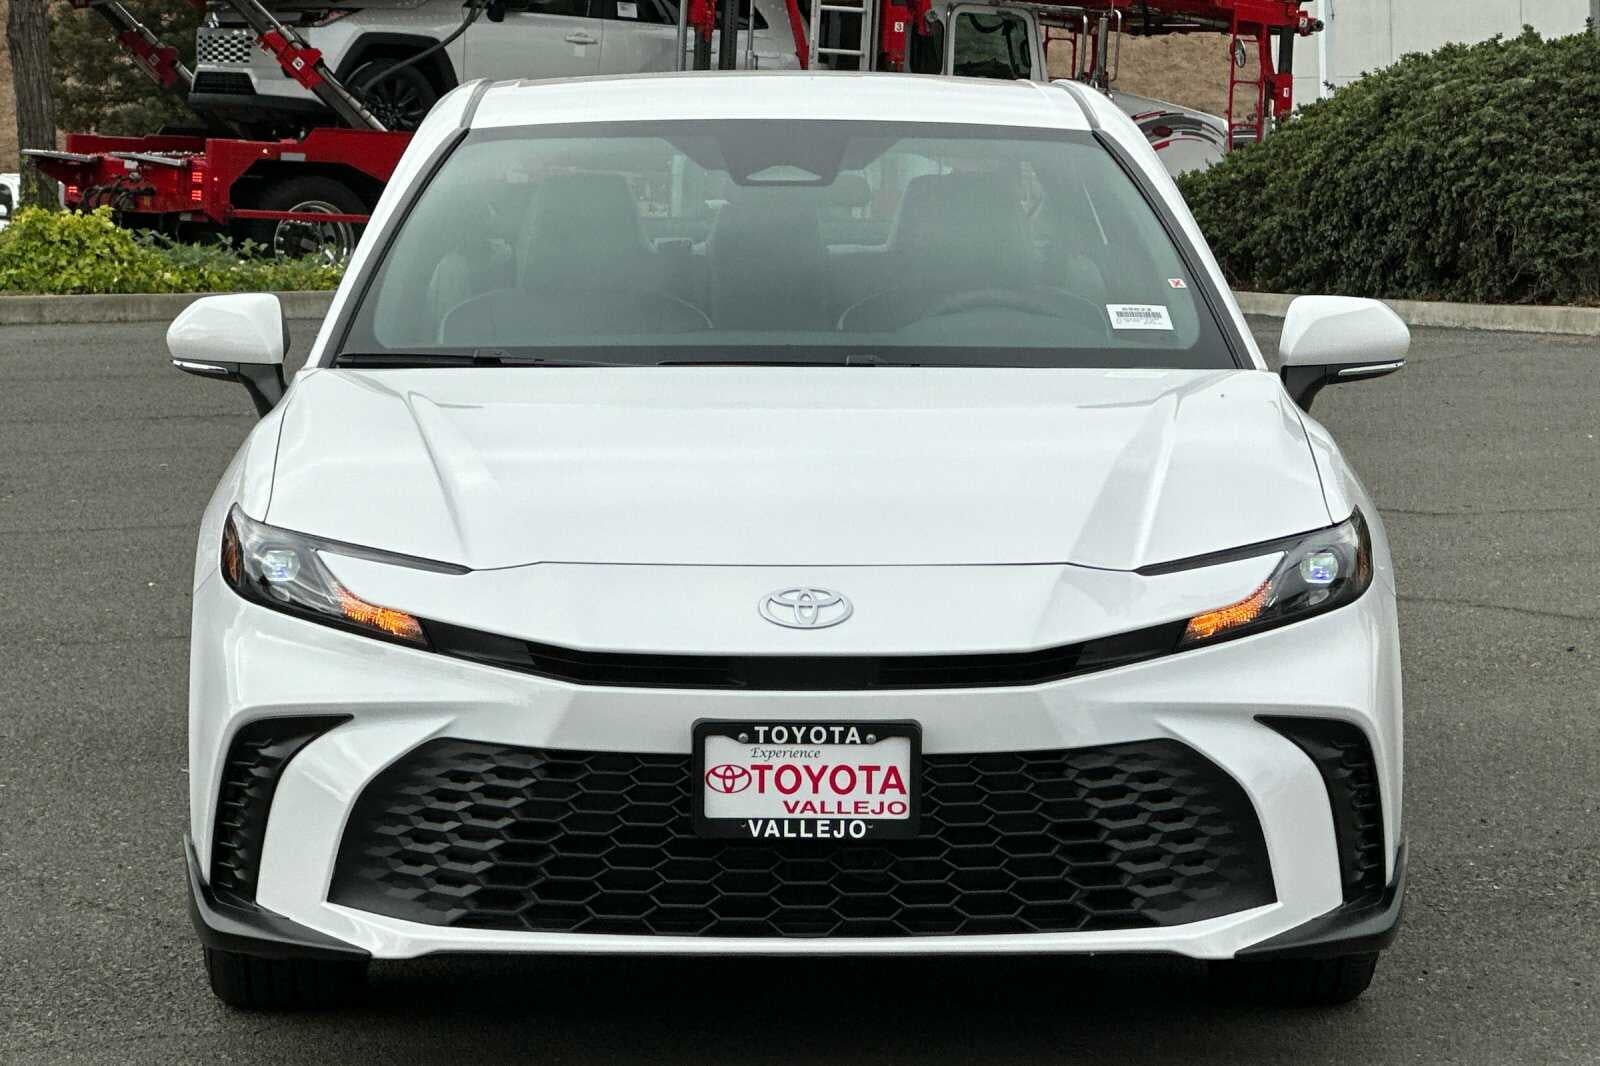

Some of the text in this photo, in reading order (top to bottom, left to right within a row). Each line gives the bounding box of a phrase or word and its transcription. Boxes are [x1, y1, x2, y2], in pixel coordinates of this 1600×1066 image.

[754, 726, 861, 744] TOYOTA
[750, 747, 821, 761] Experience
[750, 764, 907, 795] TOYOTA
[783, 800, 908, 815] VALLEJO
[748, 819, 866, 838] VALLEJO
